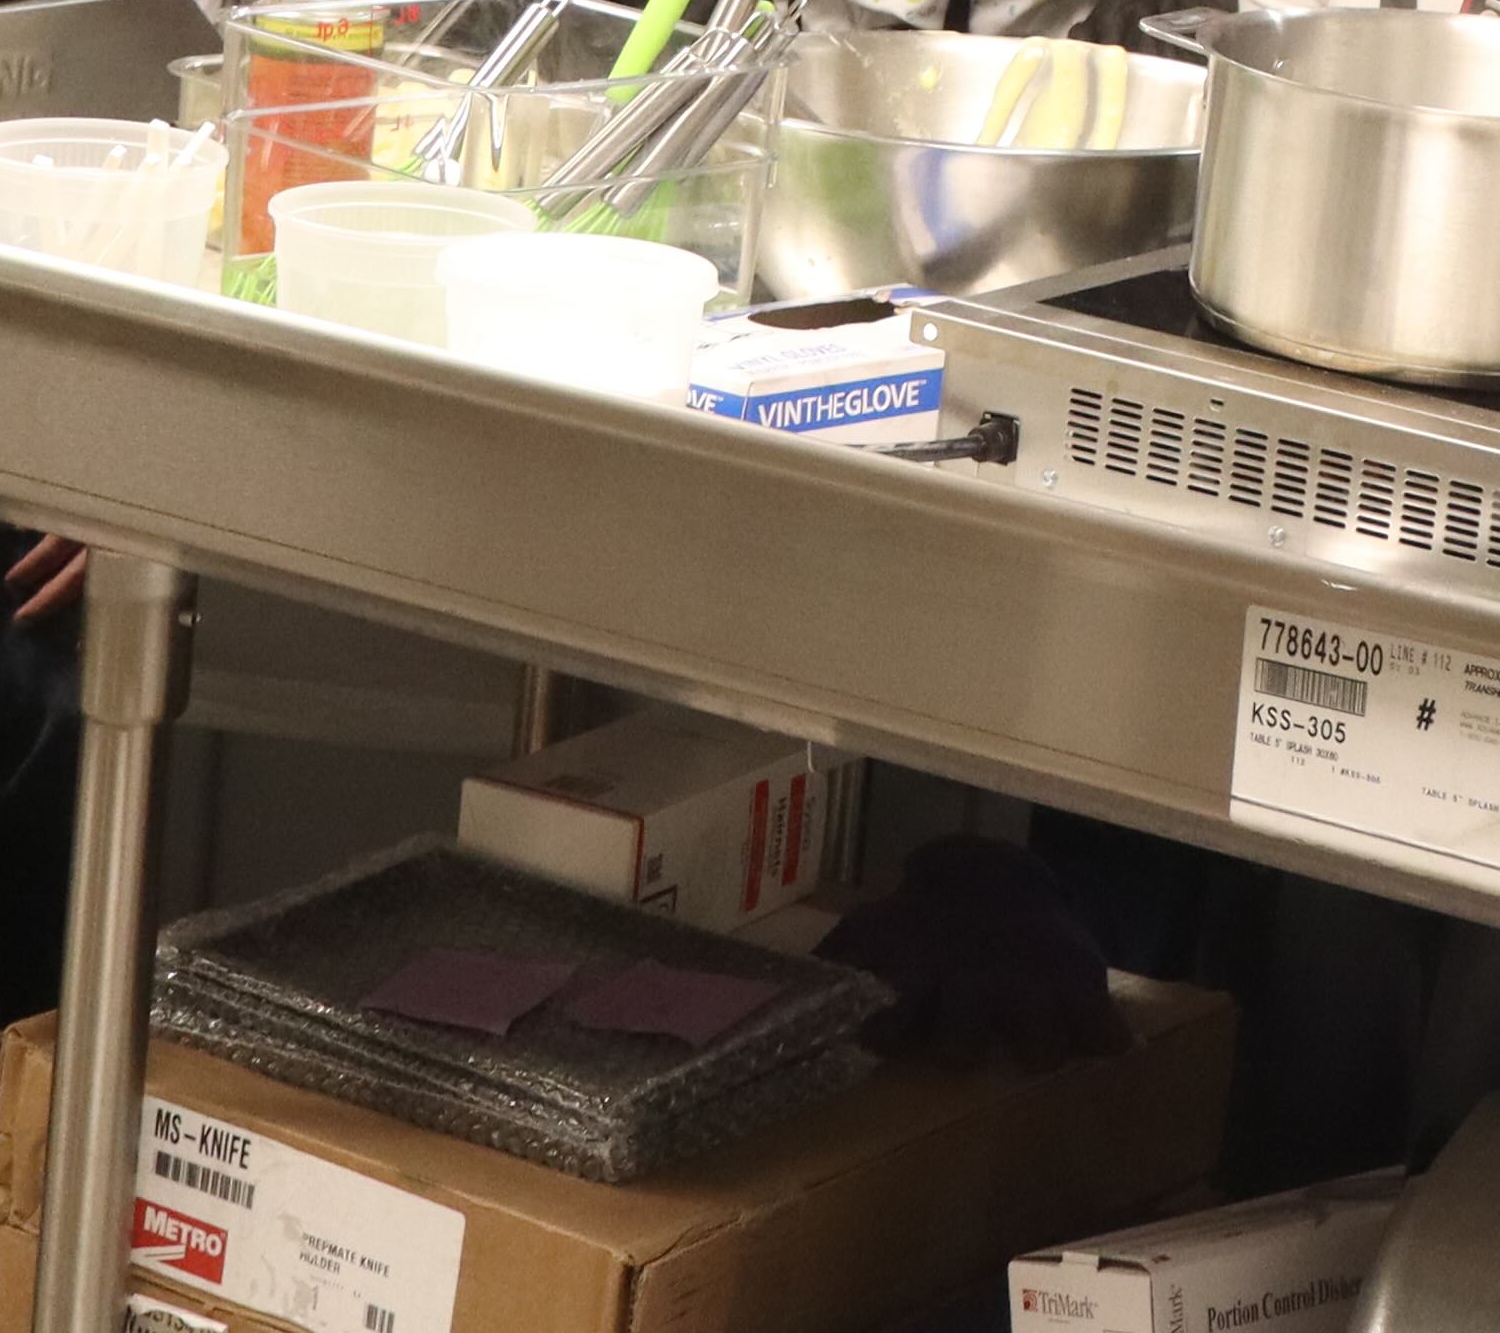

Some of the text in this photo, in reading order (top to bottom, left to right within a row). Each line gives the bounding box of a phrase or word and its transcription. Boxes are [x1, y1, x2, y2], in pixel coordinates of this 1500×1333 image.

[1260, 617, 1383, 676] 778643-00
[1389, 644, 1415, 664] LINE
[1434, 652, 1452, 671] 112
[1252, 702, 1346, 744] KSS-305
[1416, 698, 1436, 731] #
[1250, 732, 1271, 747] TABLE
[1286, 741, 1312, 756] SPLASH
[1421, 786, 1447, 801] TABLE
[1468, 798, 1499, 813] SPLASH
[154, 1108, 252, 1170] MS-KNIFE
[143, 1205, 223, 1257] METRO
[302, 1232, 390, 1277] PREPMATE KNIFE
[1038, 1290, 1094, 1320] TriMark
[1207, 1300, 1260, 1333] Portion
[1262, 1287, 1316, 1321] Control
